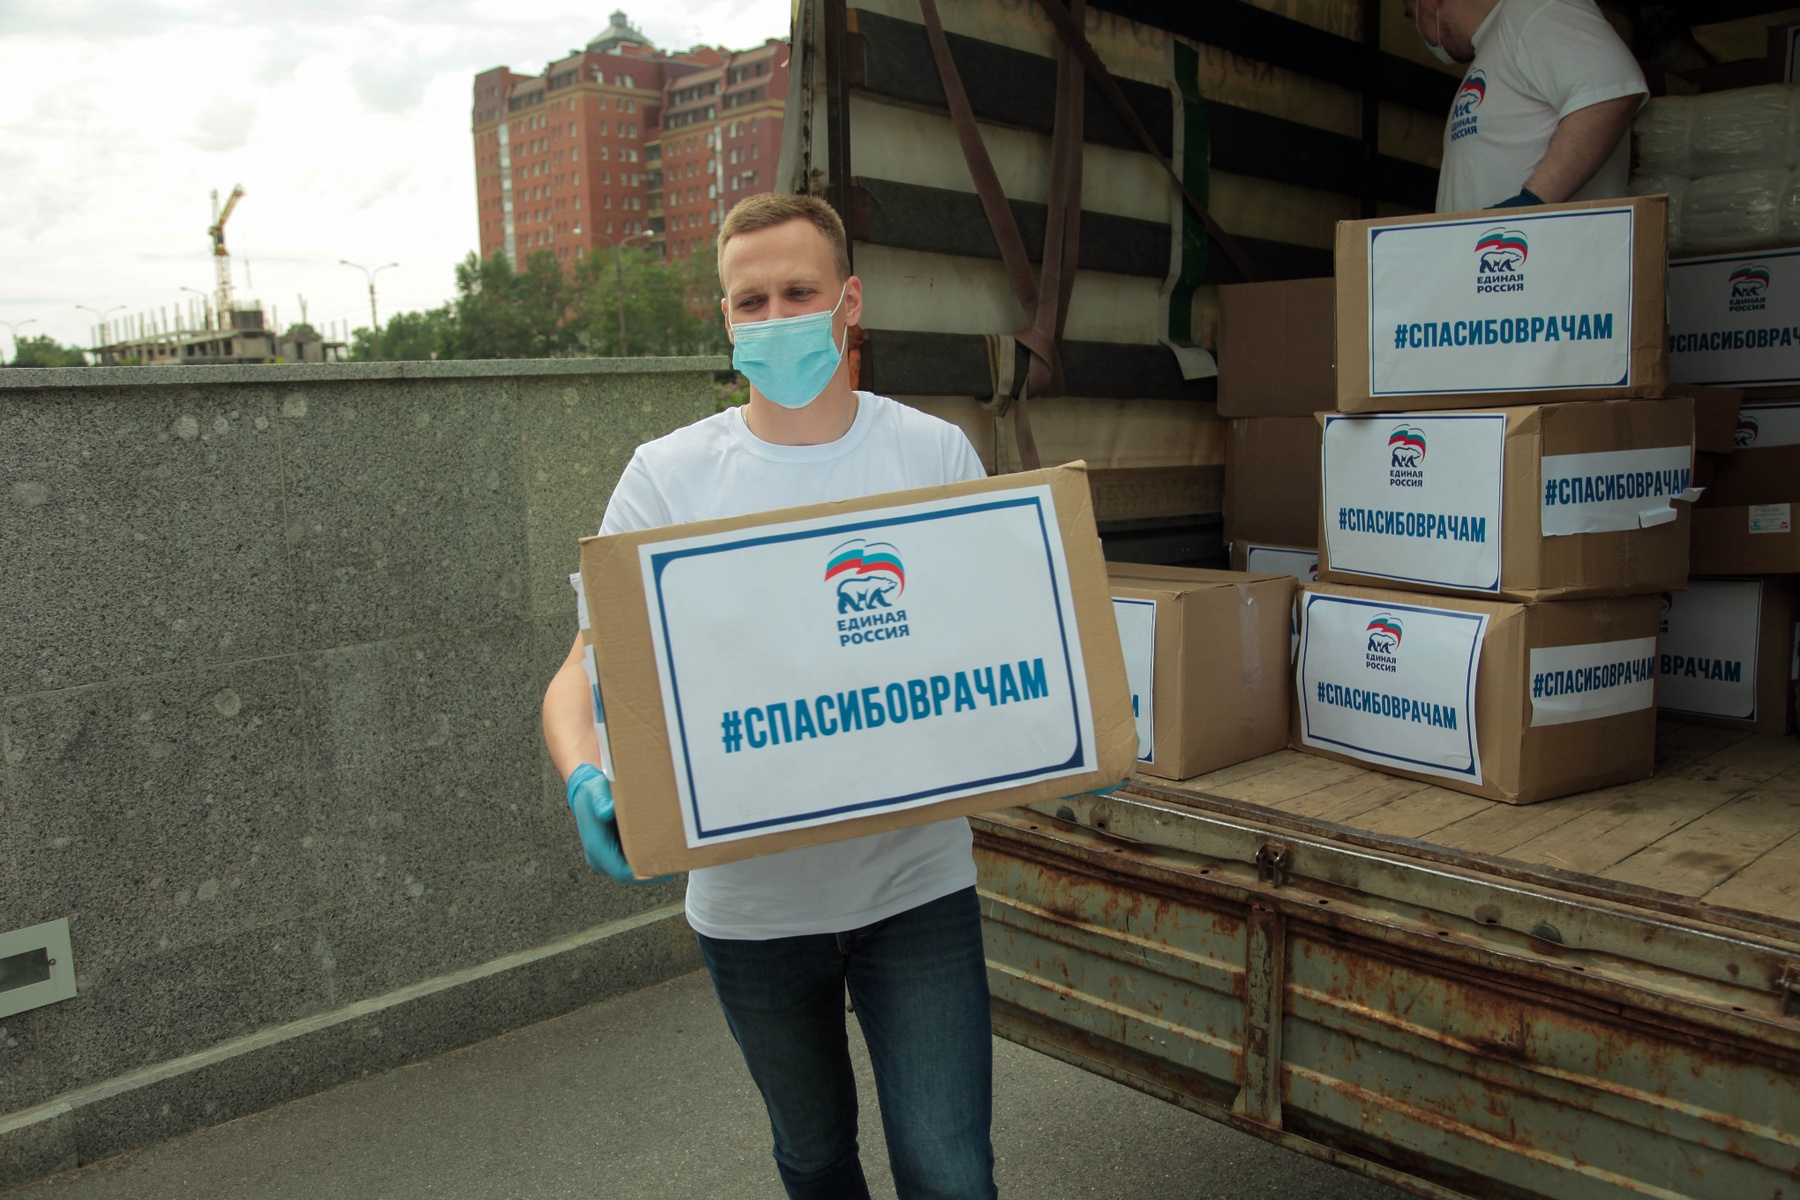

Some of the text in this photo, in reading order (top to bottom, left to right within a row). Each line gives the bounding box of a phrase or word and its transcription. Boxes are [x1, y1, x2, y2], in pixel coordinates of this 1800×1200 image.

[1477, 274, 1524, 284] ЕДИНАЯ
[1477, 283, 1524, 293] РОССИЯ
[1729, 297, 1766, 305] ЕДИНАЯ
[1729, 304, 1766, 312] РОССИЯ
[1394, 313, 1613, 349] #СПАСИБОВРАЧАМ
[1390, 470, 1423, 478] ЕДИНАЯ
[1390, 479, 1423, 487] РОССИЯ
[1545, 468, 1690, 506] #СПАСИБОВРАЧАМ
[1339, 508, 1486, 542] #СПАСИБОВРАЧАМ
[837, 610, 907, 631] ЕДИНАЯ
[840, 625, 910, 647] РОССИЯ
[1366, 653, 1397, 664] ЕДИНАЯ
[1366, 661, 1396, 672] РОССИЯ
[1533, 656, 1656, 698] #СПАСИБОВРАЧАМ
[721, 657, 1049, 753] #СПАСИБОВРАЧАМ
[1316, 682, 1457, 730] #СПАСИБОВРАЧАМ
